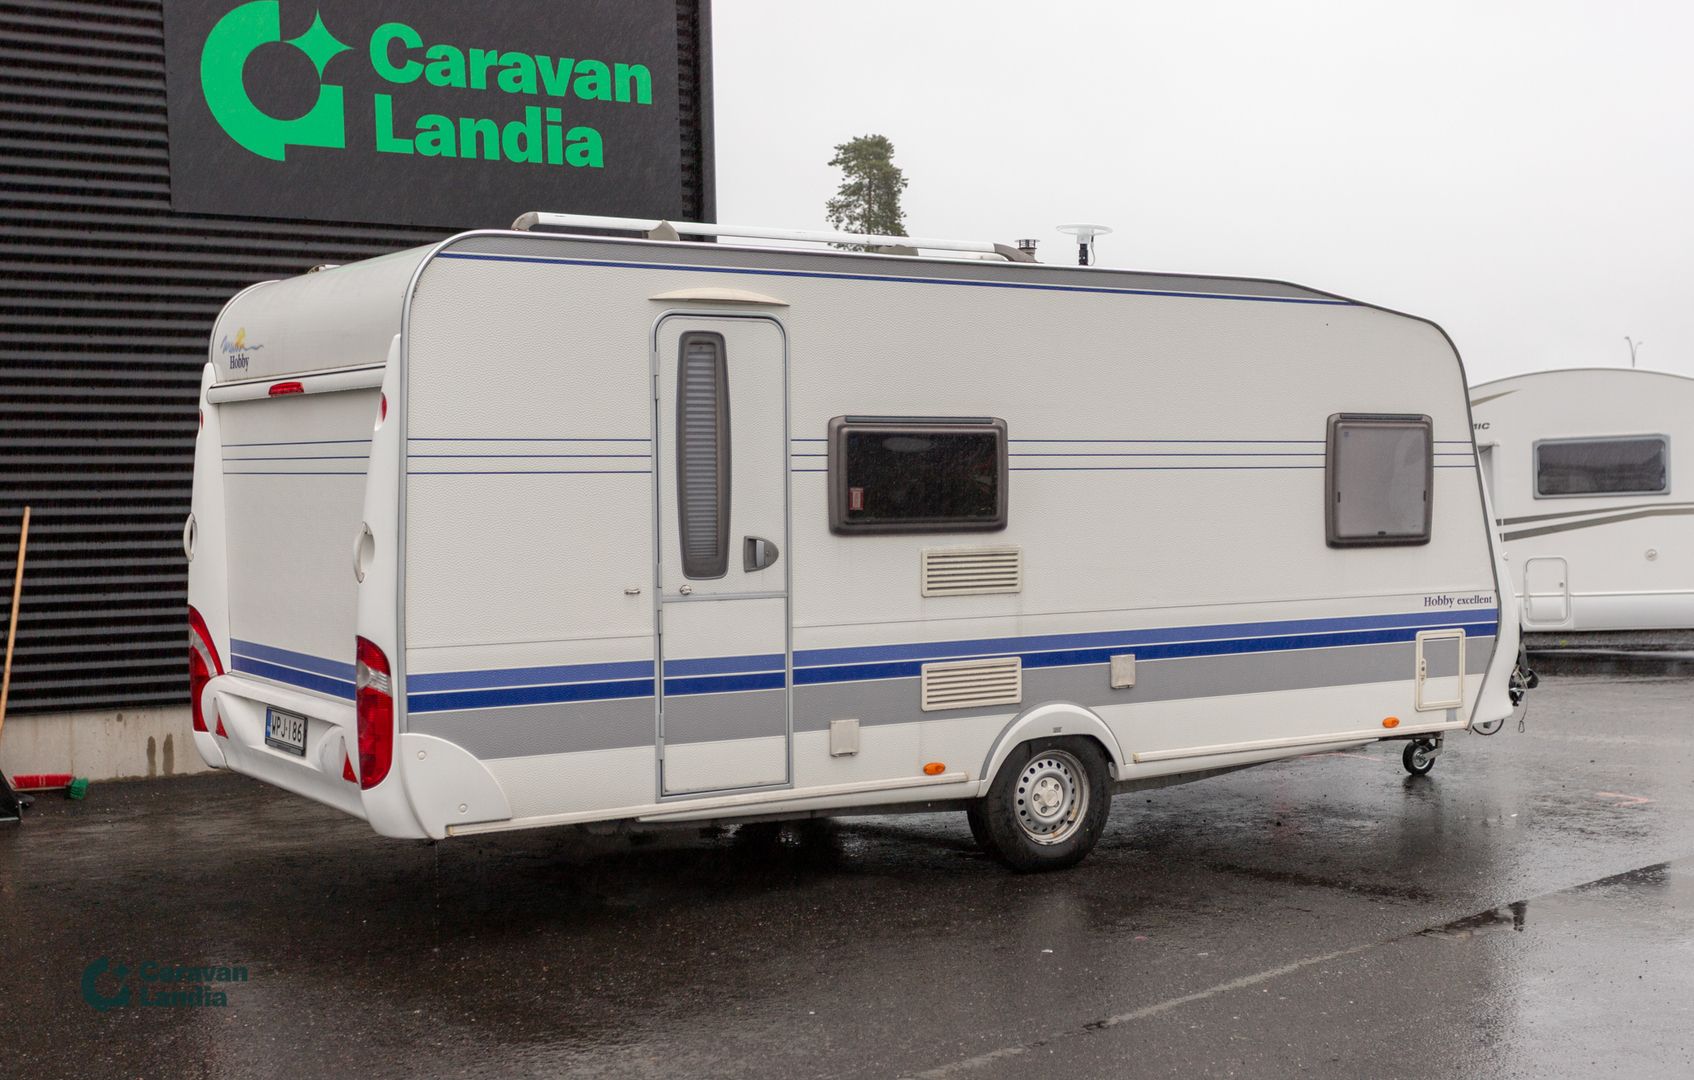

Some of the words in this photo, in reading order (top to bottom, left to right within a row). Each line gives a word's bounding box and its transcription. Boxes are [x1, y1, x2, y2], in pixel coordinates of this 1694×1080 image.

[370, 22, 652, 104] Caravan
[375, 93, 604, 168] Landia
[229, 354, 250, 372] Hobby
[1424, 595, 1455, 608] Hobby
[1456, 595, 1492, 605] excellent
[271, 714, 303, 743] WPJ-186
